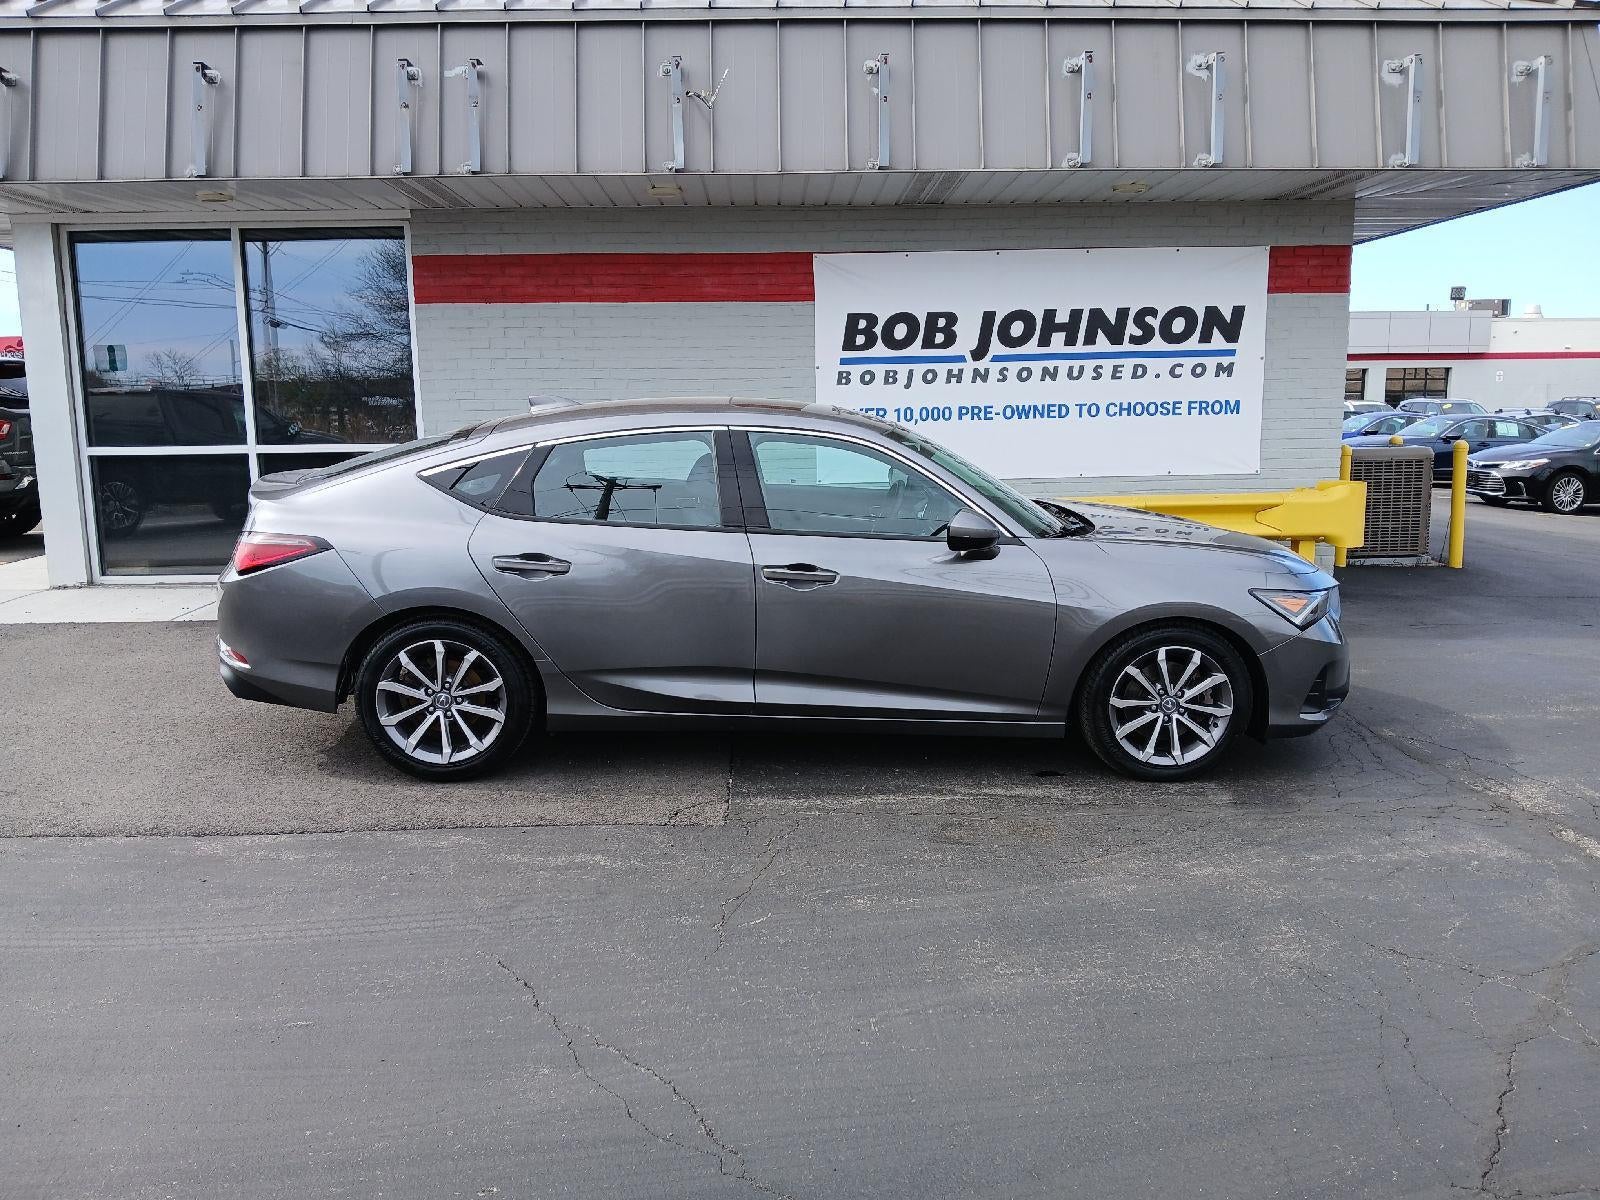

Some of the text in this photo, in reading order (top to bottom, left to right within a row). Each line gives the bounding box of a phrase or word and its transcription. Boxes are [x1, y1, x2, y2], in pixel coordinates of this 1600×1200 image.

[841, 305, 1246, 362] BOB JOHNSON
[836, 362, 1235, 390] BOBJOHNSONUSED.COM
[893, 406, 953, 425] 10,000
[957, 403, 1070, 421] PRE-OWNED
[1075, 402, 1101, 418] TO
[1105, 401, 1183, 418] CHOOSE
[1187, 399, 1241, 416] FROM
